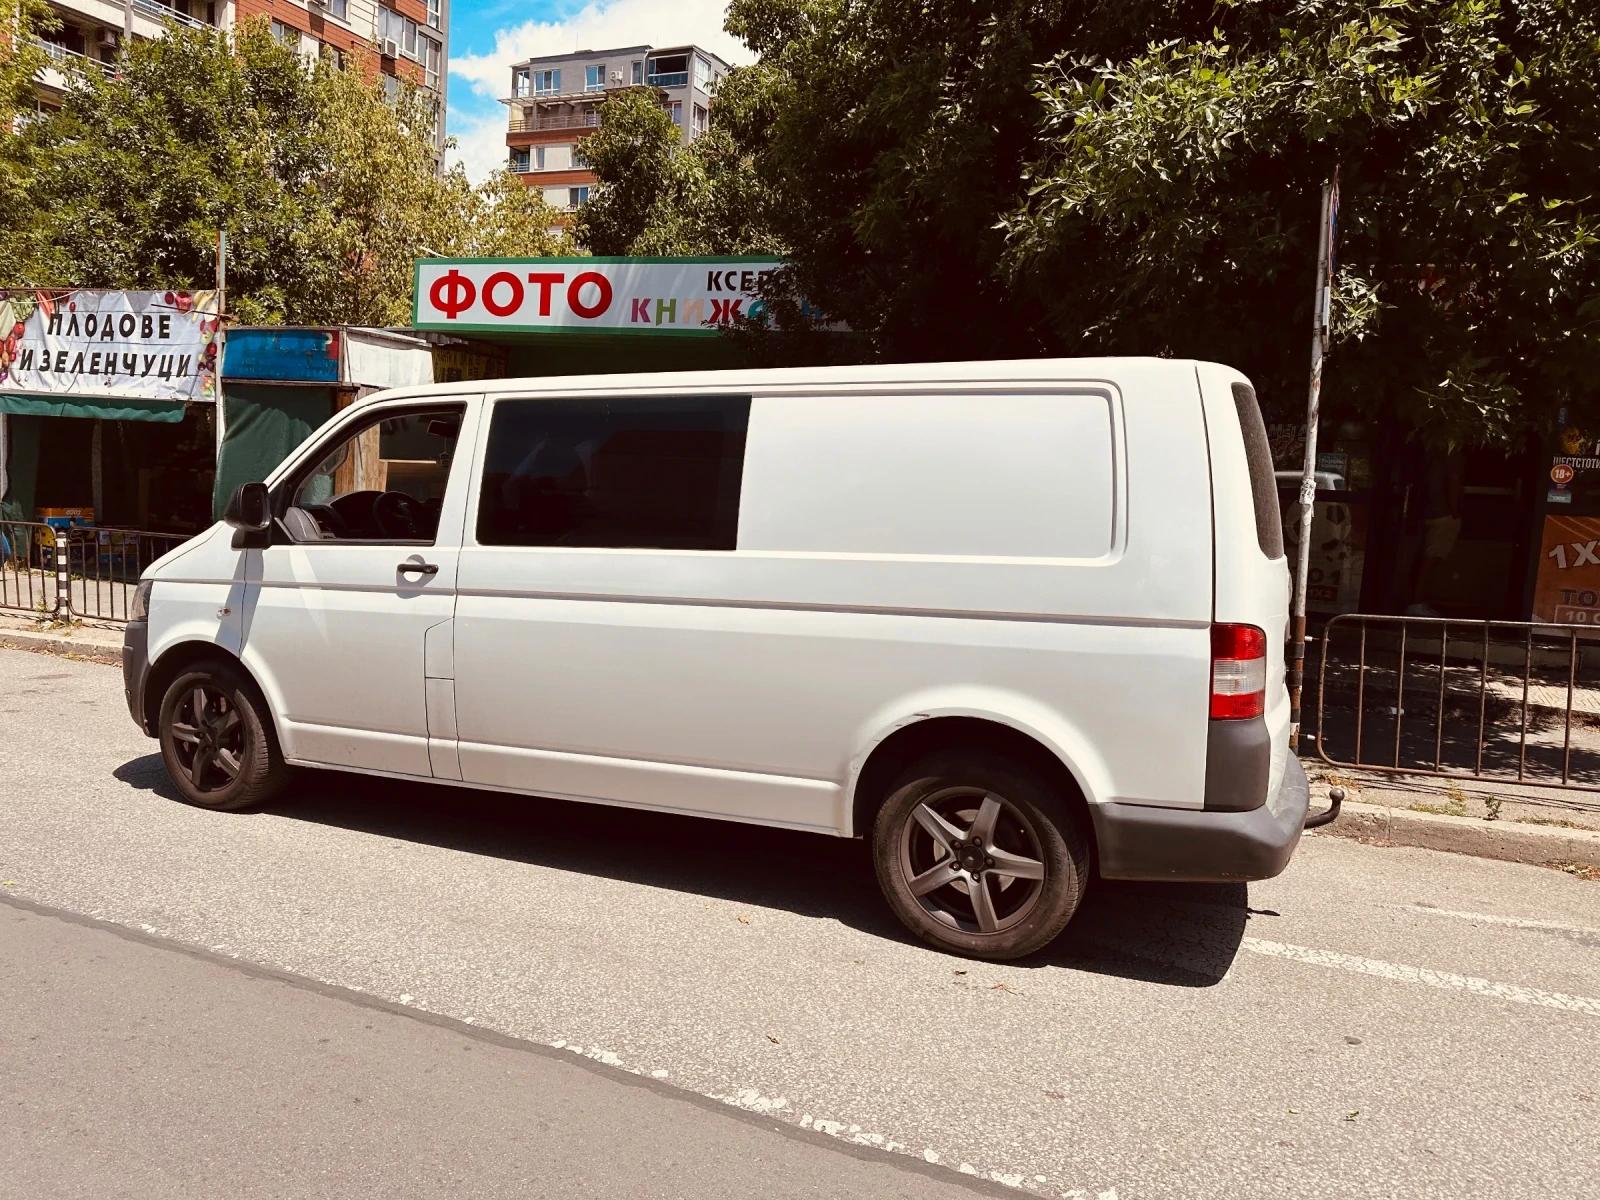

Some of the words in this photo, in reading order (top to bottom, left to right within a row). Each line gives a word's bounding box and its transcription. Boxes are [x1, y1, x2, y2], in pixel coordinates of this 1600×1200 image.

[707, 271, 797, 291] КСЕР
[429, 269, 613, 319] ФОТО
[47, 313, 171, 341] ПЛОДОВЕ
[1555, 469, 1572, 479] 18+
[1560, 588, 1600, 606] ТО
